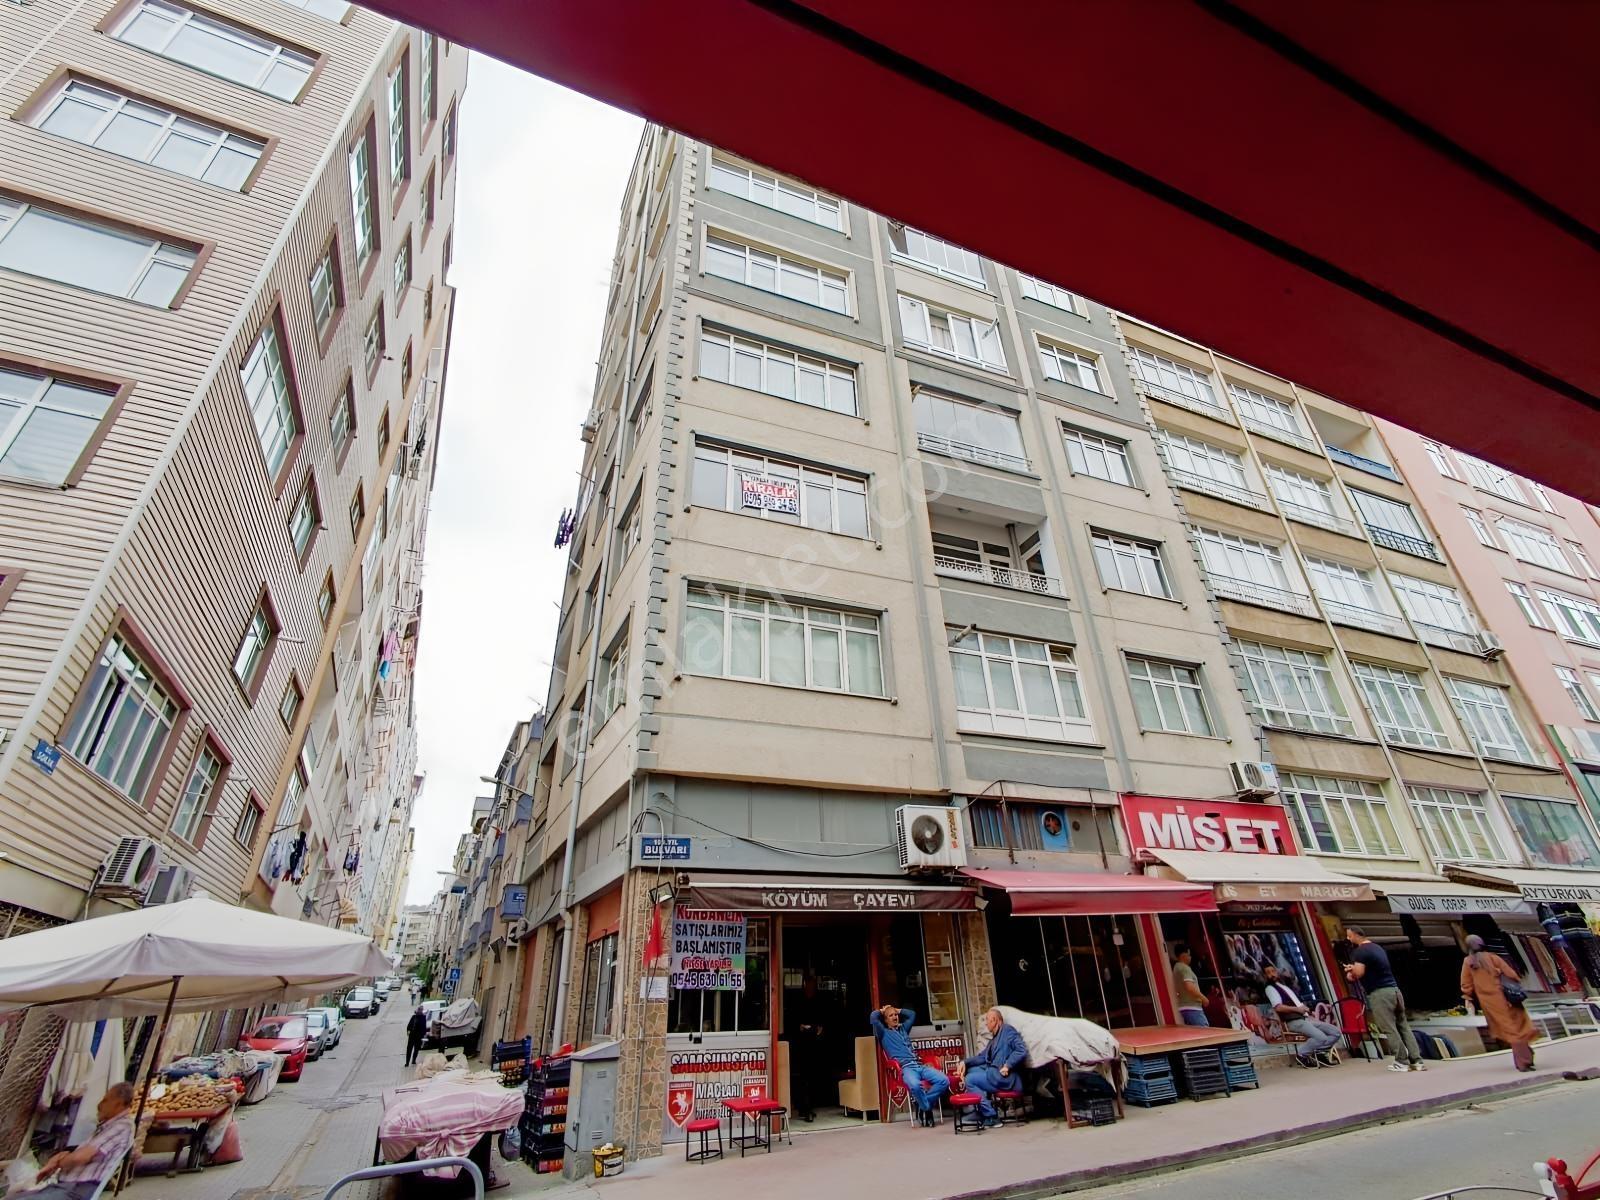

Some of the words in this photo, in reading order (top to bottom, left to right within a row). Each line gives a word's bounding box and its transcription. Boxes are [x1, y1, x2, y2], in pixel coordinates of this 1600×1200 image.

[762, 890, 828, 907] KÖYÜM
[1258, 885, 1277, 897] ET
[1300, 886, 1358, 898] MARKET
[675, 923, 743, 939] SATIŞLARIMIZ
[675, 940, 741, 957] BAŞLAMIŞTIR
[670, 1050, 767, 1074] SAMSUNSPOR
